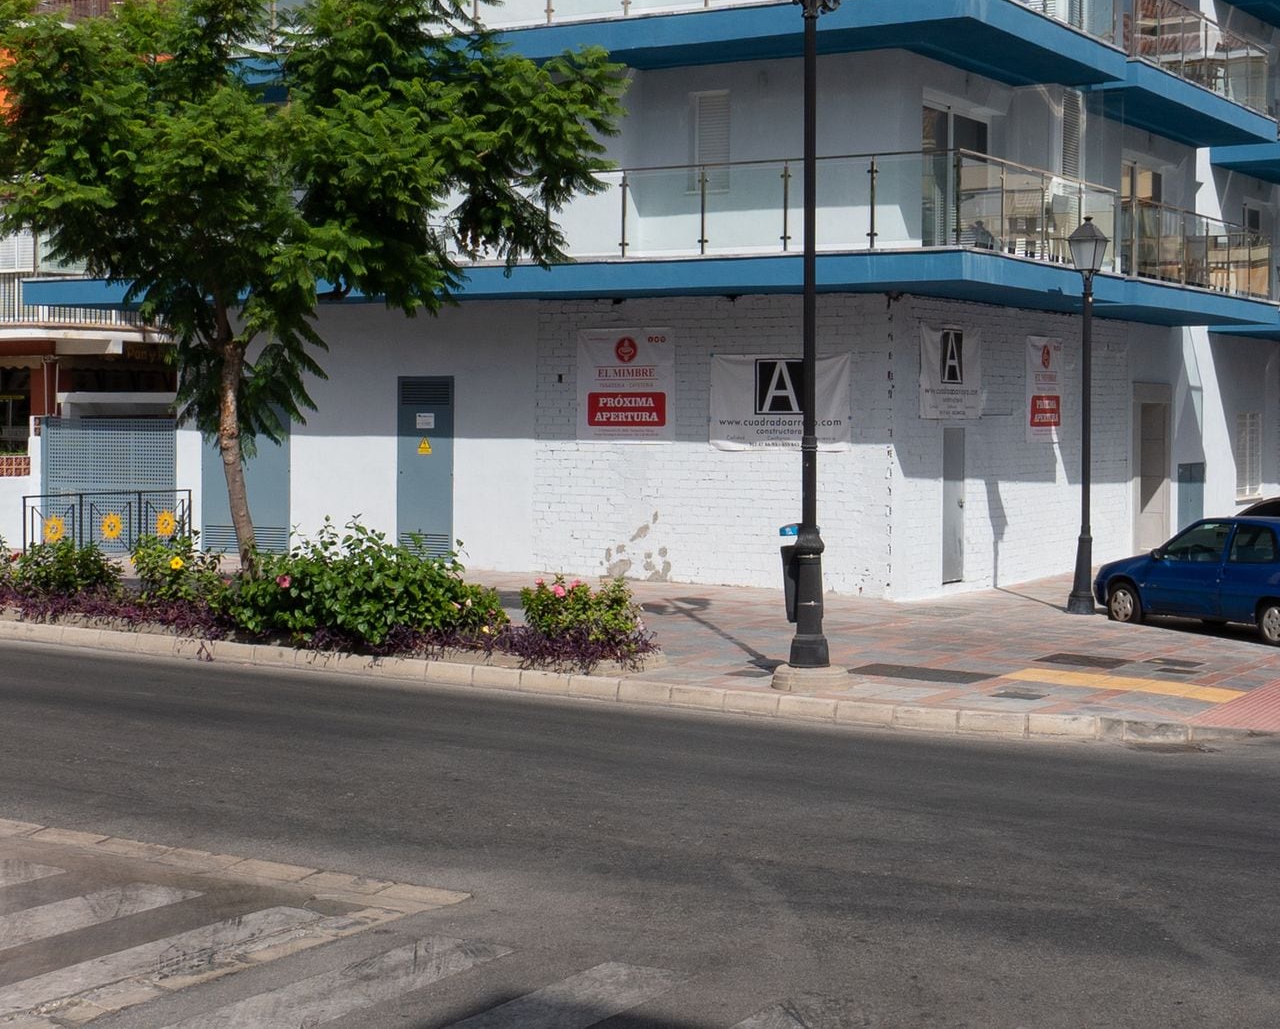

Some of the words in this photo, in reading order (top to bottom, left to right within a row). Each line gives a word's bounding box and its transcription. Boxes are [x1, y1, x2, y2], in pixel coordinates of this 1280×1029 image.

[943, 331, 961, 381] A
[598, 368, 611, 378] EL
[613, 368, 655, 378] MIMBRE
[761, 361, 800, 412] A
[599, 395, 655, 407] PRÓXIMA
[594, 412, 659, 422] APERTURA
